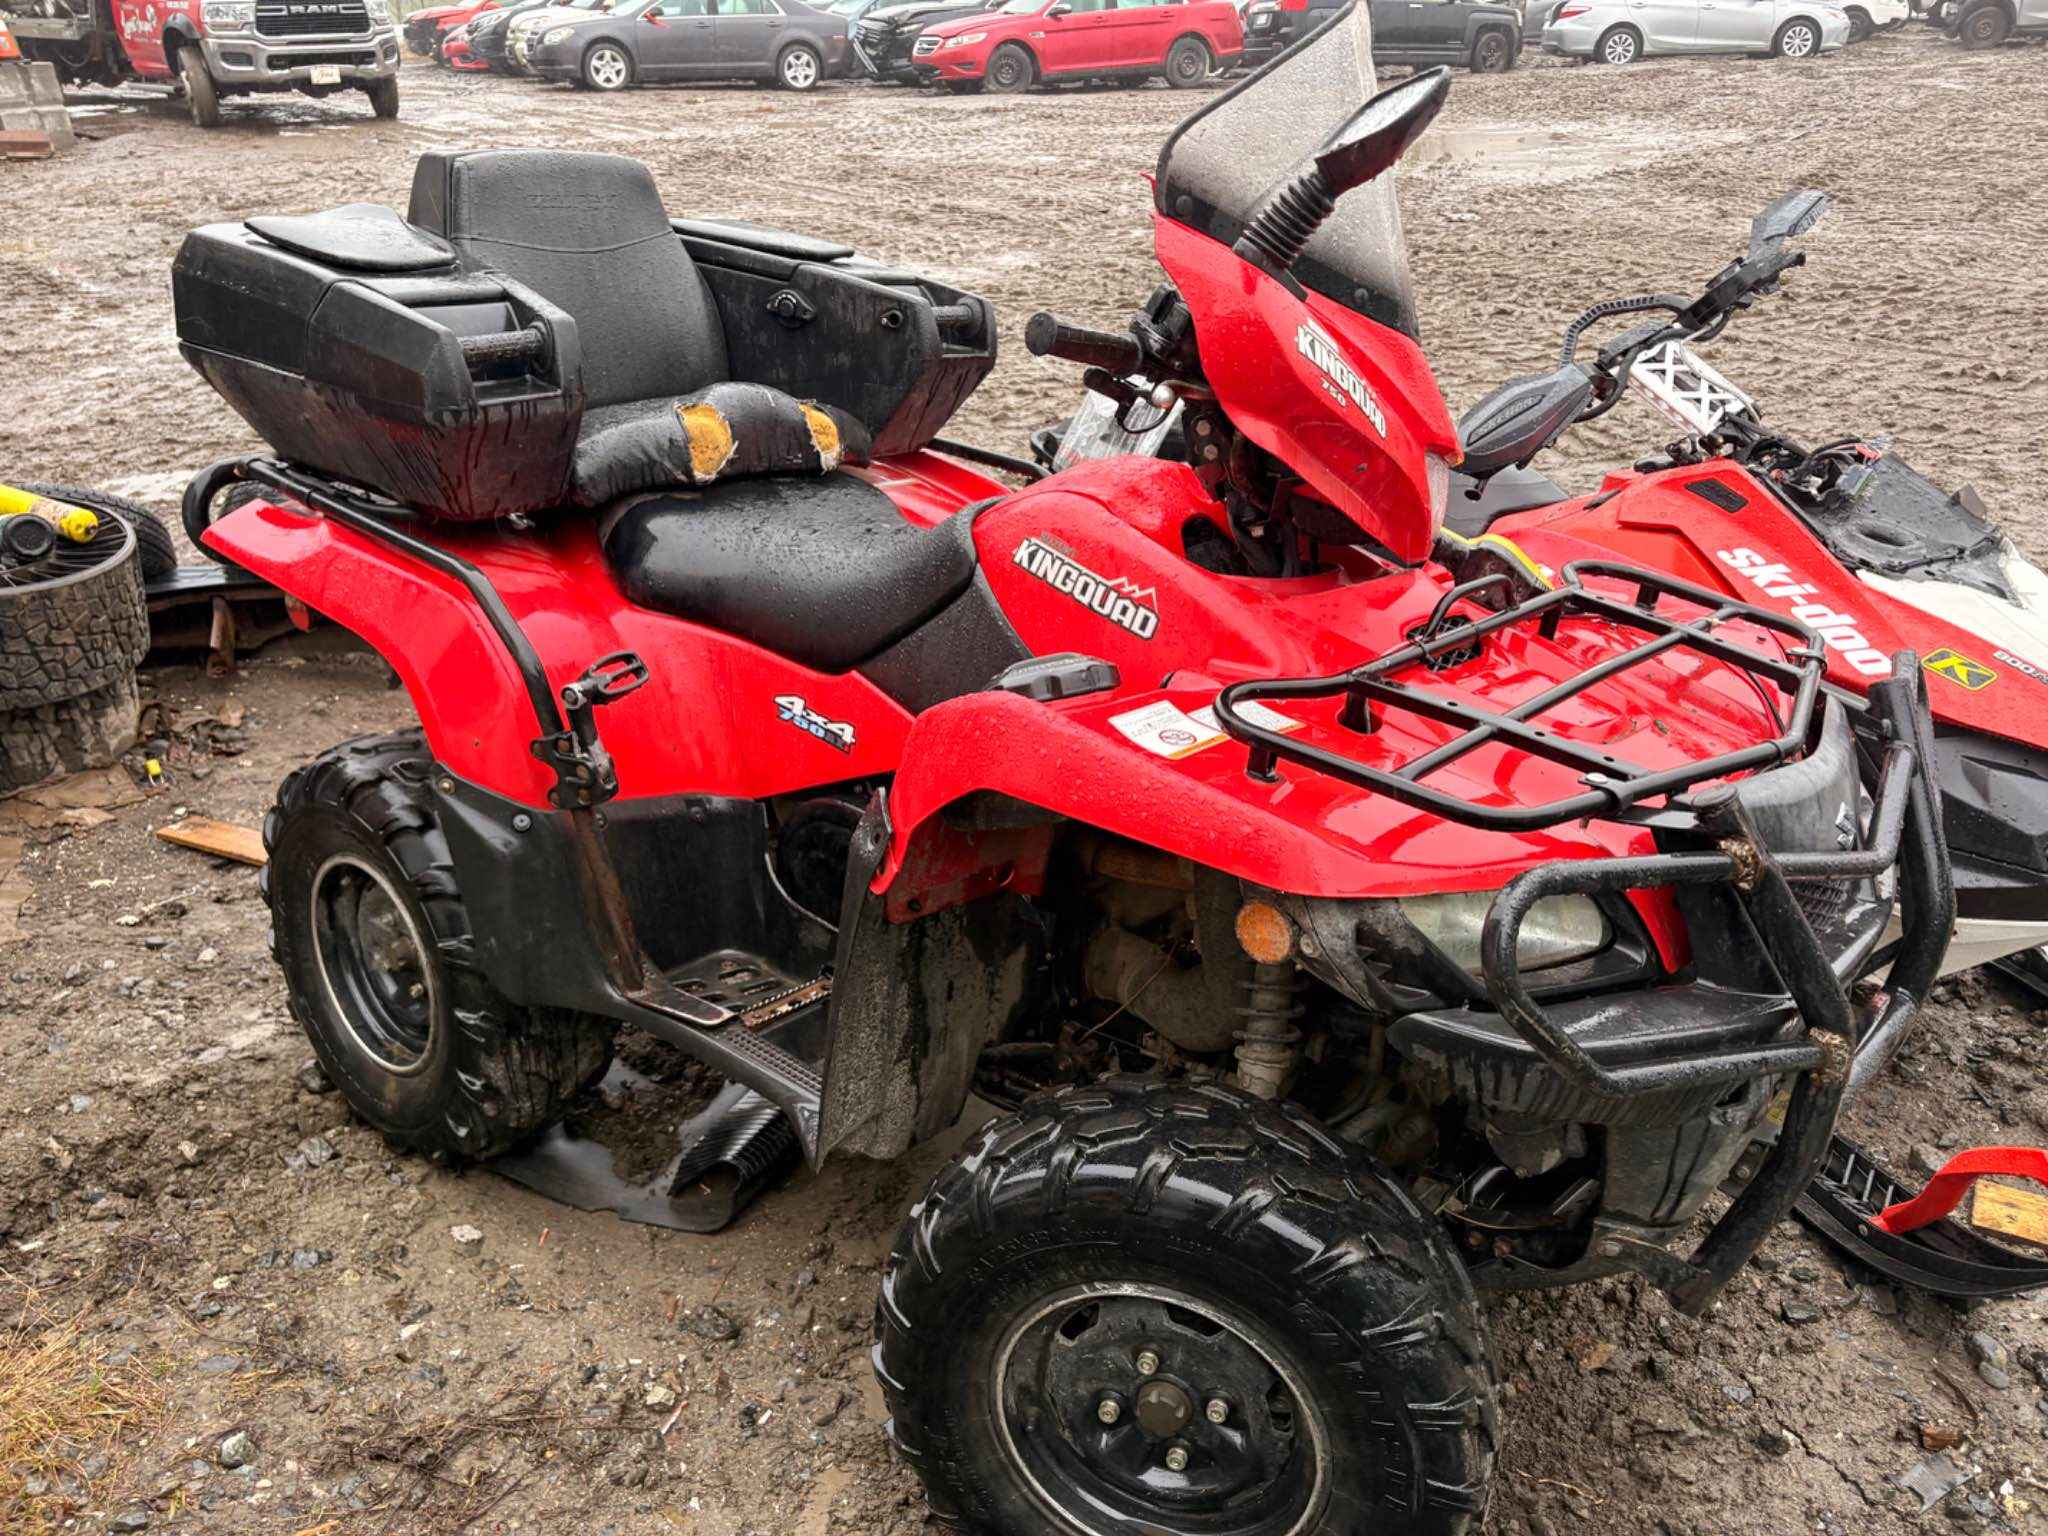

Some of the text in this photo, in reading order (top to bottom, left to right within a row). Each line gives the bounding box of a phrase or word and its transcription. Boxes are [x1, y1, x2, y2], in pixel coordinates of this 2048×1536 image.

[290, 5, 338, 13] RAM
[1296, 325, 1387, 438] KINGQUAD
[1013, 539, 1159, 637] KINGQUAD
[1717, 547, 1892, 676] ski-doo
[774, 695, 856, 743] 4x4
